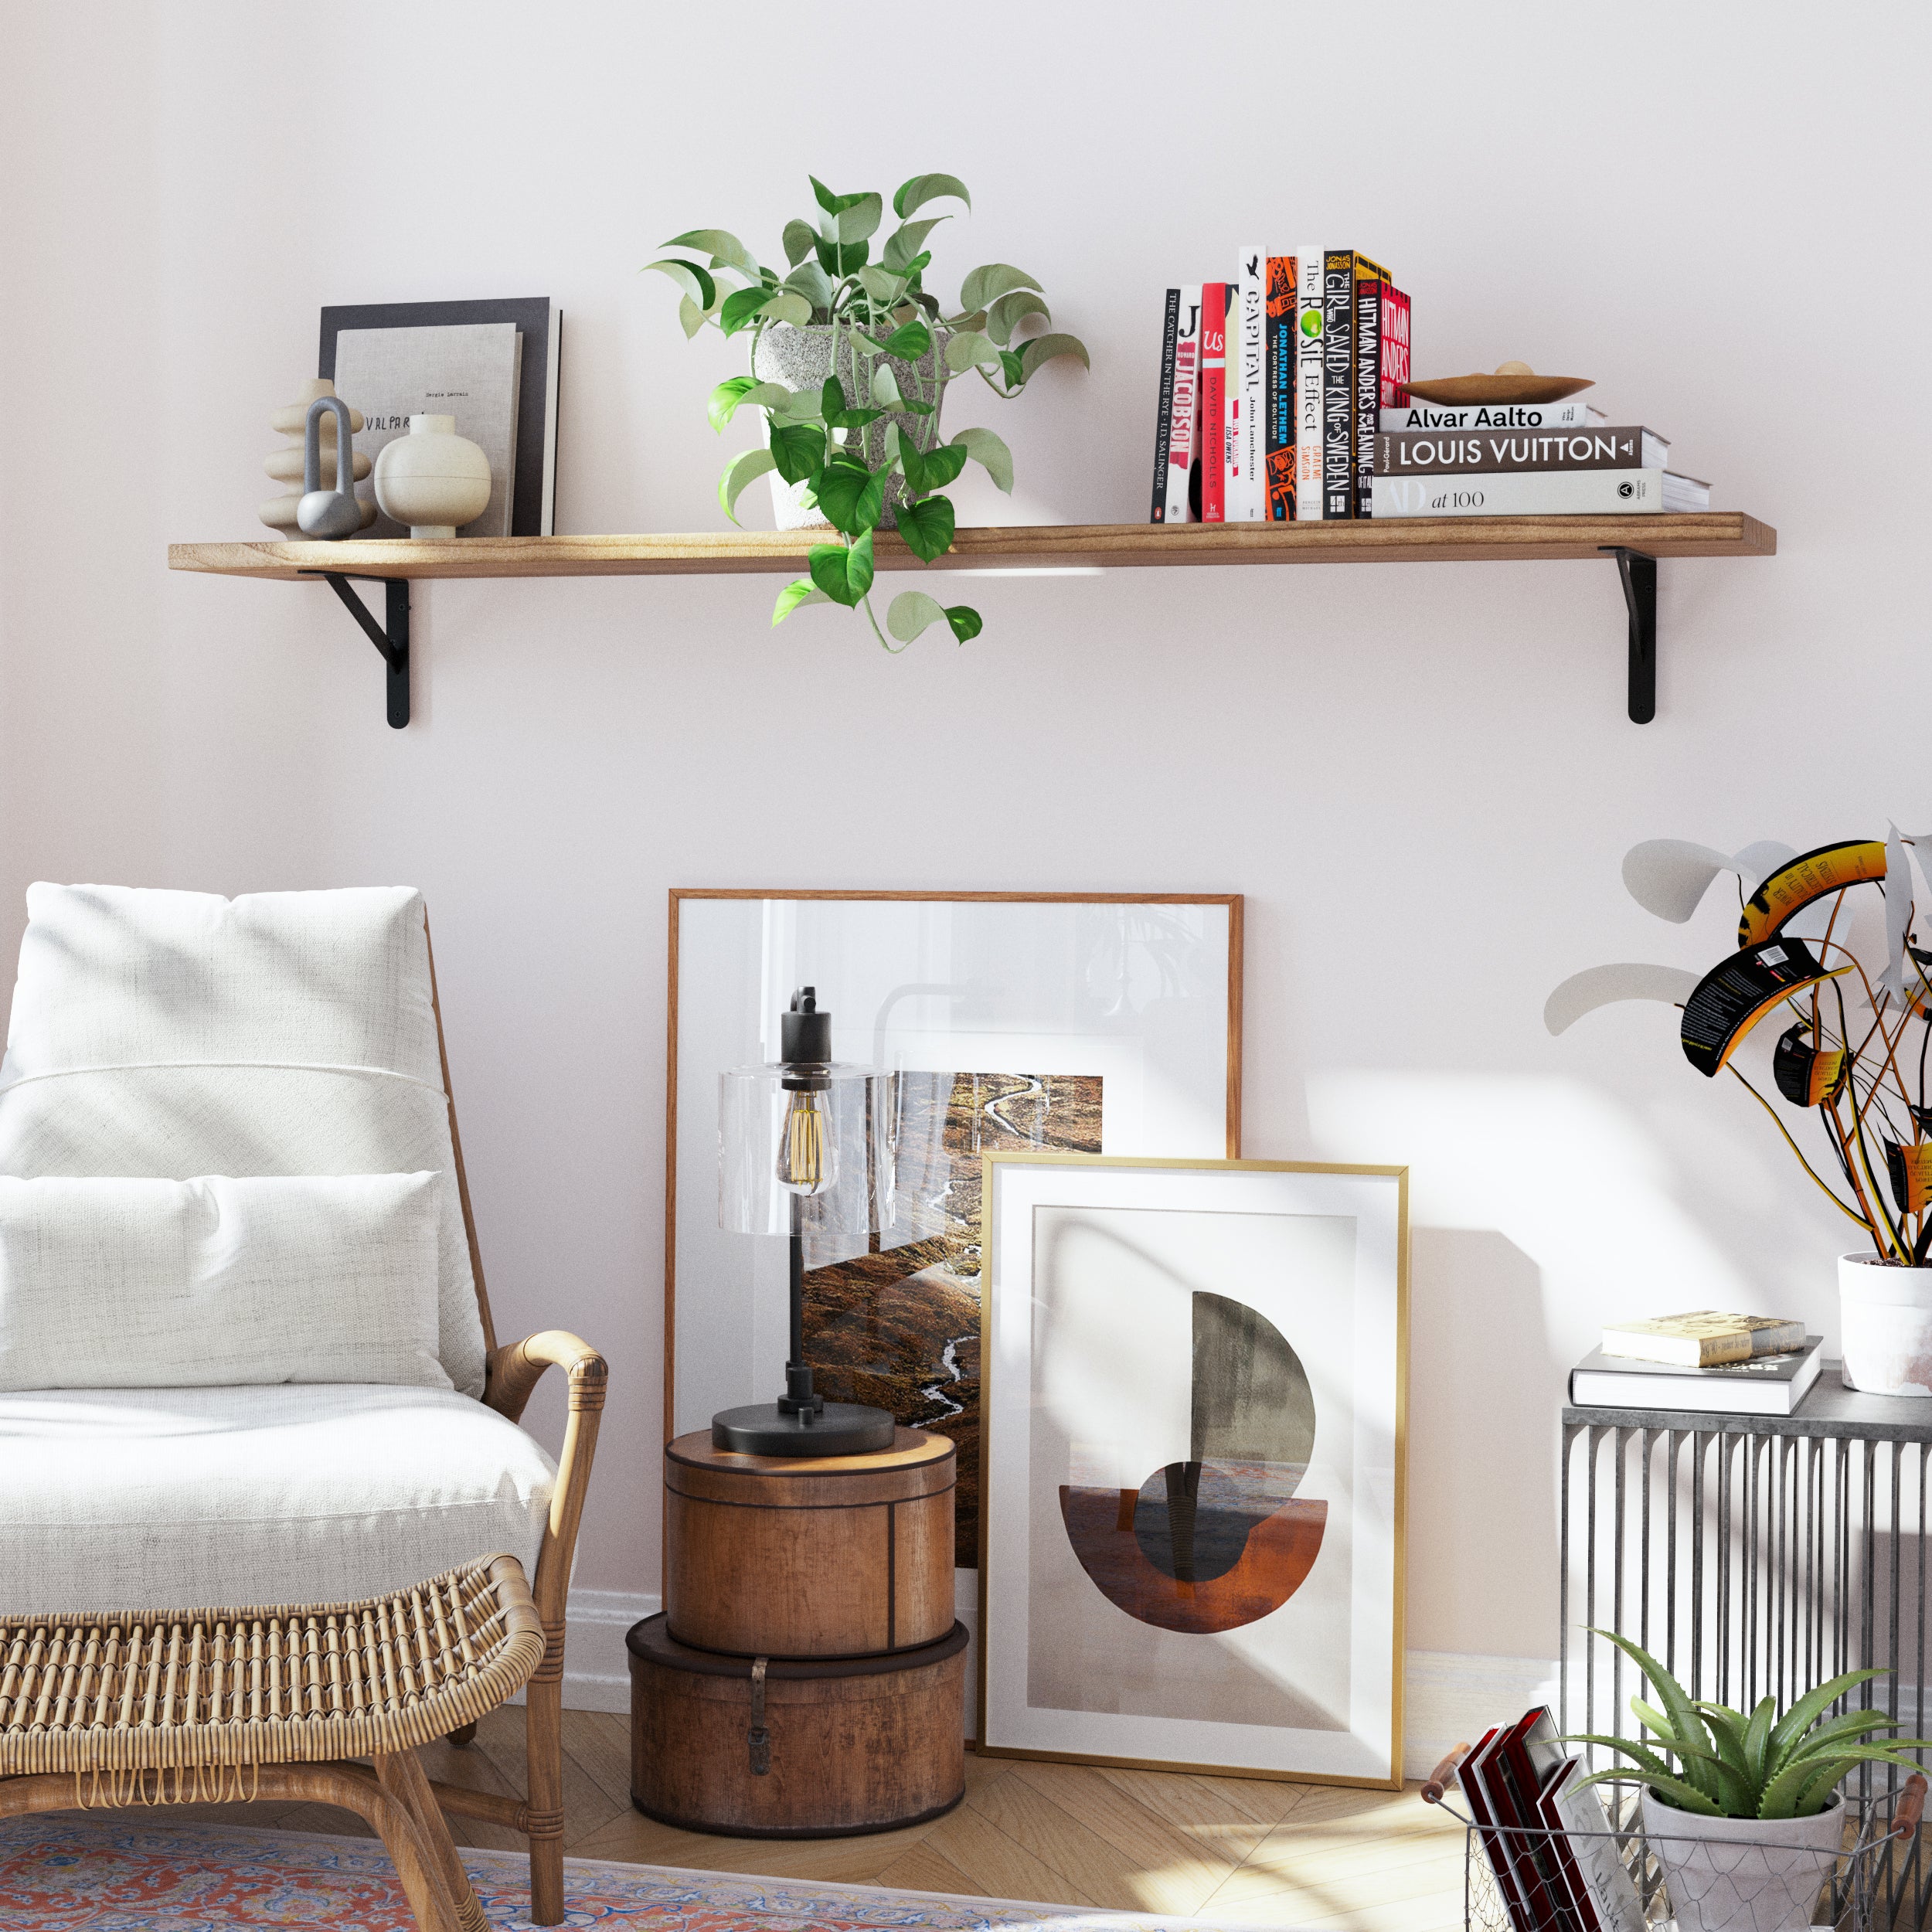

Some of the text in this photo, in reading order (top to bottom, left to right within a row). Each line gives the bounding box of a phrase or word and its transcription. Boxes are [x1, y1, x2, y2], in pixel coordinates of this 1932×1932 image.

[1307, 260, 1318, 291] The
[1325, 254, 1351, 264] JONAS
[1326, 261, 1351, 270] JONASSON
[1168, 293, 1177, 313] THE
[1325, 274, 1350, 321] GIRL
[1179, 305, 1200, 338] J
[1326, 308, 1335, 323] WHO
[1358, 298, 1377, 354] HITMAN
[1382, 298, 1409, 347] HITMAN
[1165, 315, 1175, 361] CATCHER
[1246, 289, 1260, 391] CAPITAL
[1325, 323, 1350, 373] SAVED
[1165, 362, 1172, 374] IN
[1382, 338, 1409, 384] ANDERS
[1162, 375, 1172, 396] THE
[1272, 391, 1277, 401] OF
[1278, 323, 1287, 444] JONATHAN LETHEM
[1332, 375, 1345, 385] THE
[1358, 358, 1376, 410] ANDERS
[1161, 397, 1170, 416] RYE
[1170, 360, 1194, 452] JACOBSON
[1304, 373, 1320, 431] Effect
[1325, 387, 1350, 423] KING
[1406, 406, 1543, 427] Alvar Aalto
[1334, 423, 1342, 434] OF
[1357, 413, 1374, 474] MEANING
[1156, 440, 1167, 489] SALINGER
[1312, 445, 1321, 480] GRAEME
[1325, 430, 1350, 491] SWEDEN
[1400, 435, 1616, 464] LOUIS VUITTON
[1432, 493, 1448, 509] at
[1452, 491, 1485, 508] 100
